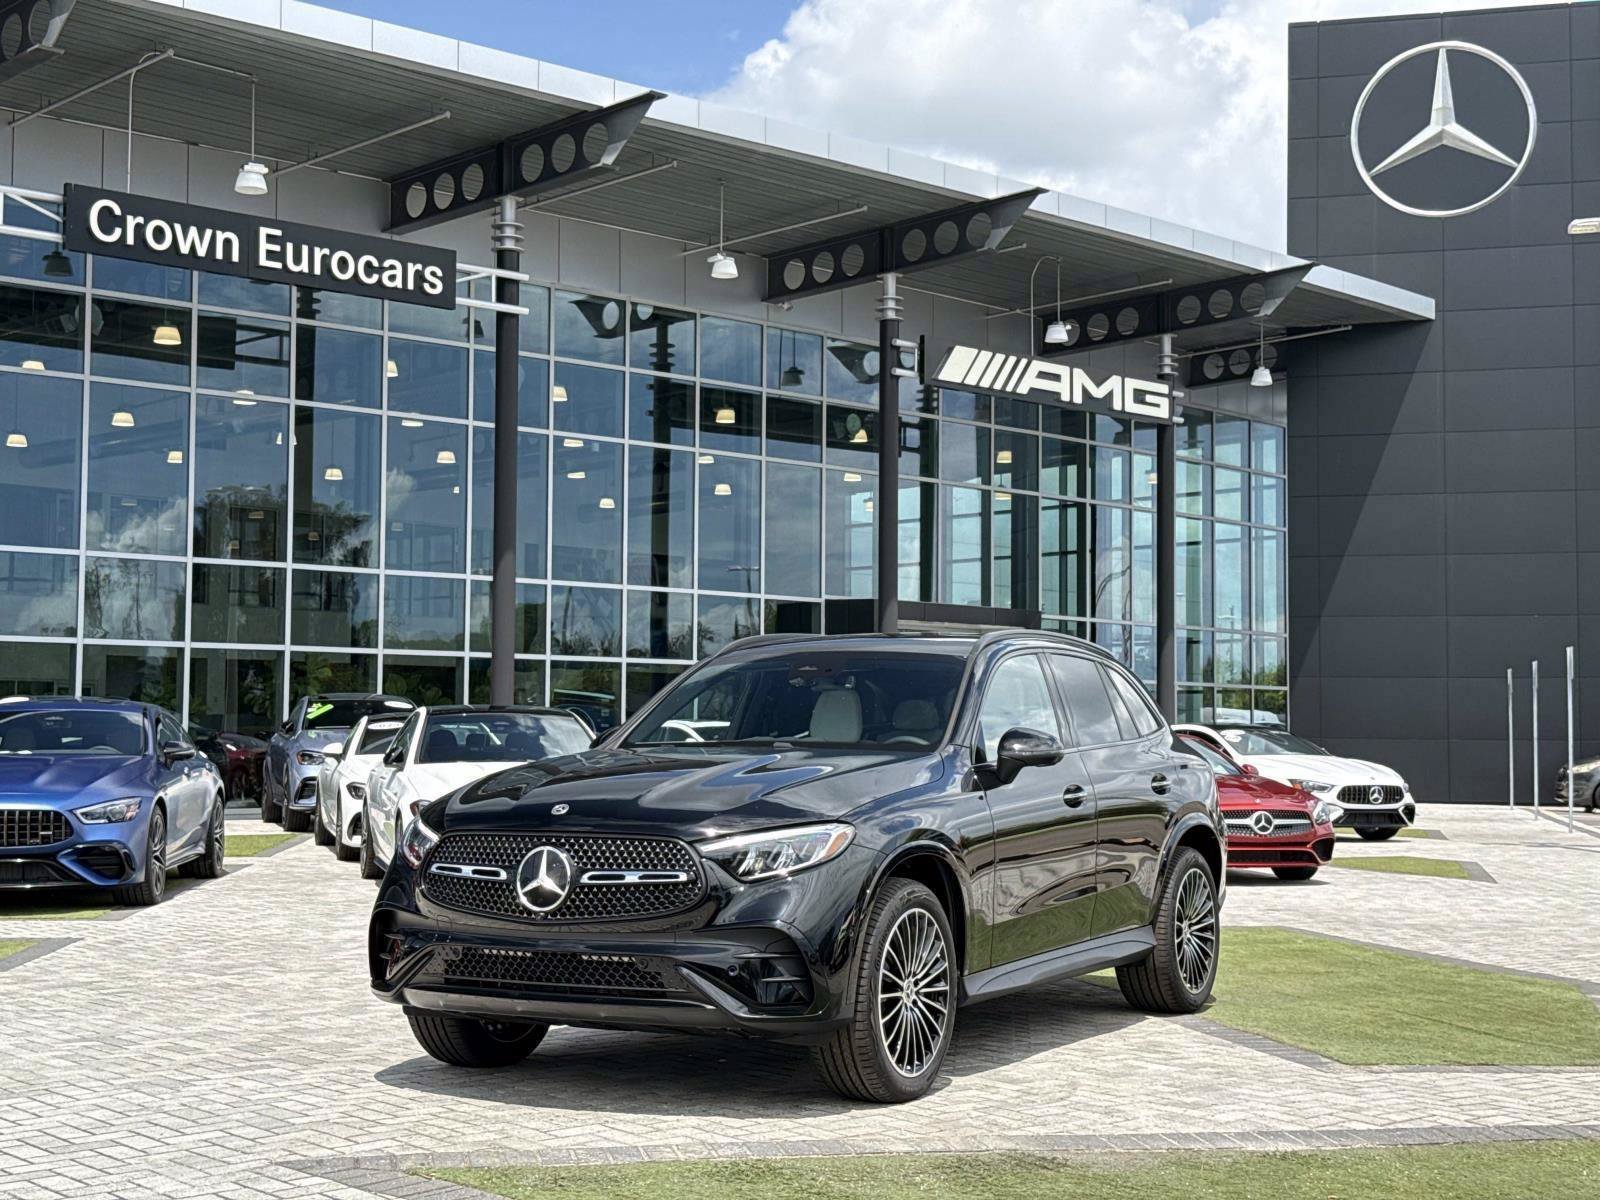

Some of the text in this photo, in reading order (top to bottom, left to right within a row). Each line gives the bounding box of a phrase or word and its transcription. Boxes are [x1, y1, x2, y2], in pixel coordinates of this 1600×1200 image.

[89, 199, 444, 296] Crown Eurocars
[1015, 359, 1170, 419] AMG
